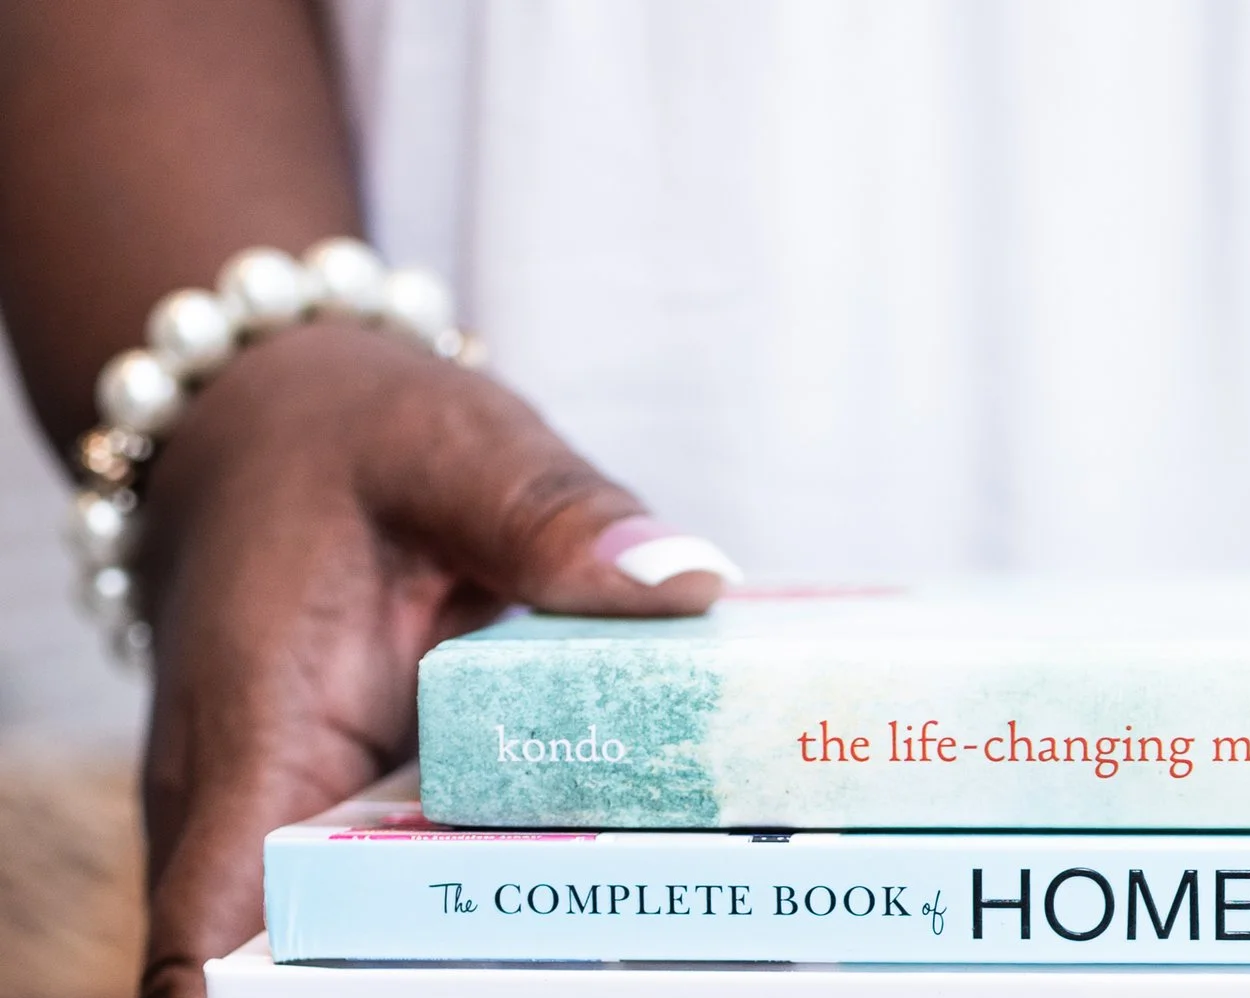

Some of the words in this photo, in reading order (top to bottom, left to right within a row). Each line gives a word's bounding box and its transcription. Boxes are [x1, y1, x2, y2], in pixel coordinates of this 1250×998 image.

[494, 723, 626, 763] kondo
[797, 720, 871, 763] the
[887, 719, 1196, 780] life-changing
[428, 883, 478, 915] The
[493, 883, 753, 916] COMPLETE
[772, 885, 912, 917] BOOK
[921, 889, 948, 936] of
